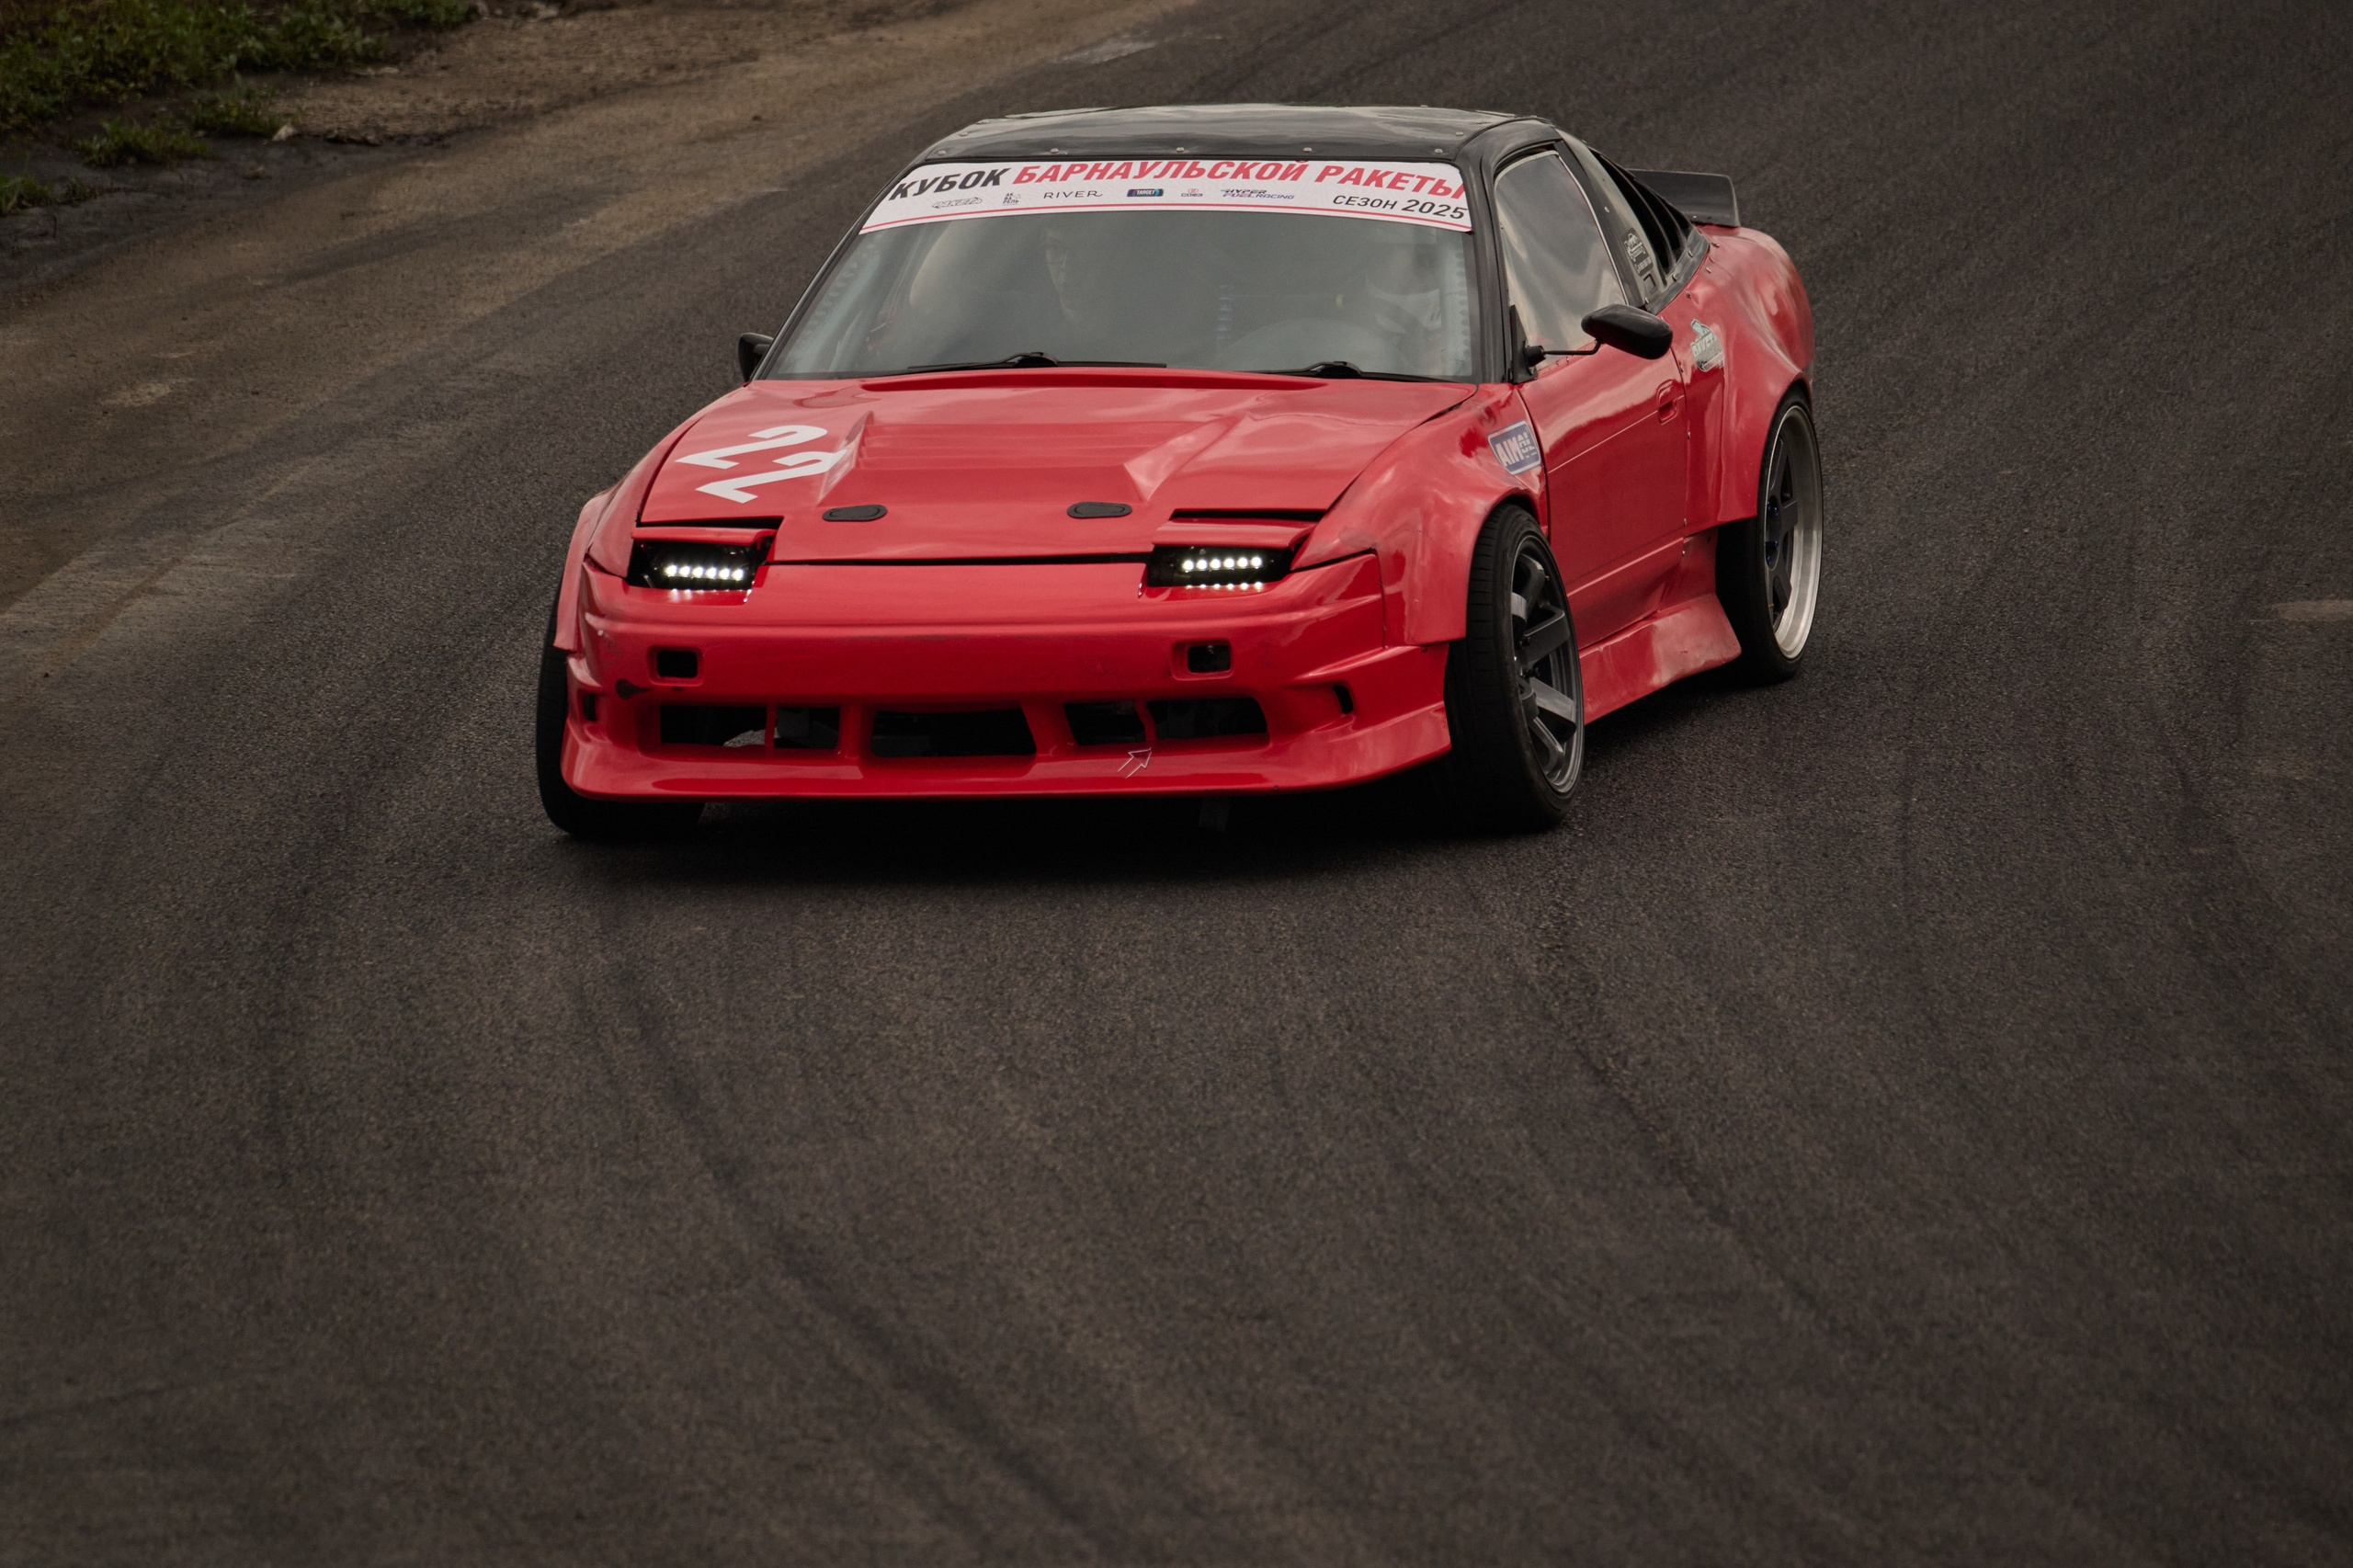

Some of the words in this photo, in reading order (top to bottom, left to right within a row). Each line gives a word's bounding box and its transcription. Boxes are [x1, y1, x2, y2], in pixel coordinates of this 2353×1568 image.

[888, 168, 1011, 200] КУБОК
[1012, 160, 1310, 185] БАРНАУЛЬСКОЙ
[1314, 165, 1465, 199] РАКЕТЫ
[1043, 190, 1103, 199] RIVER
[1333, 195, 1398, 210] СЕЗОН
[1402, 199, 1468, 220] 2025
